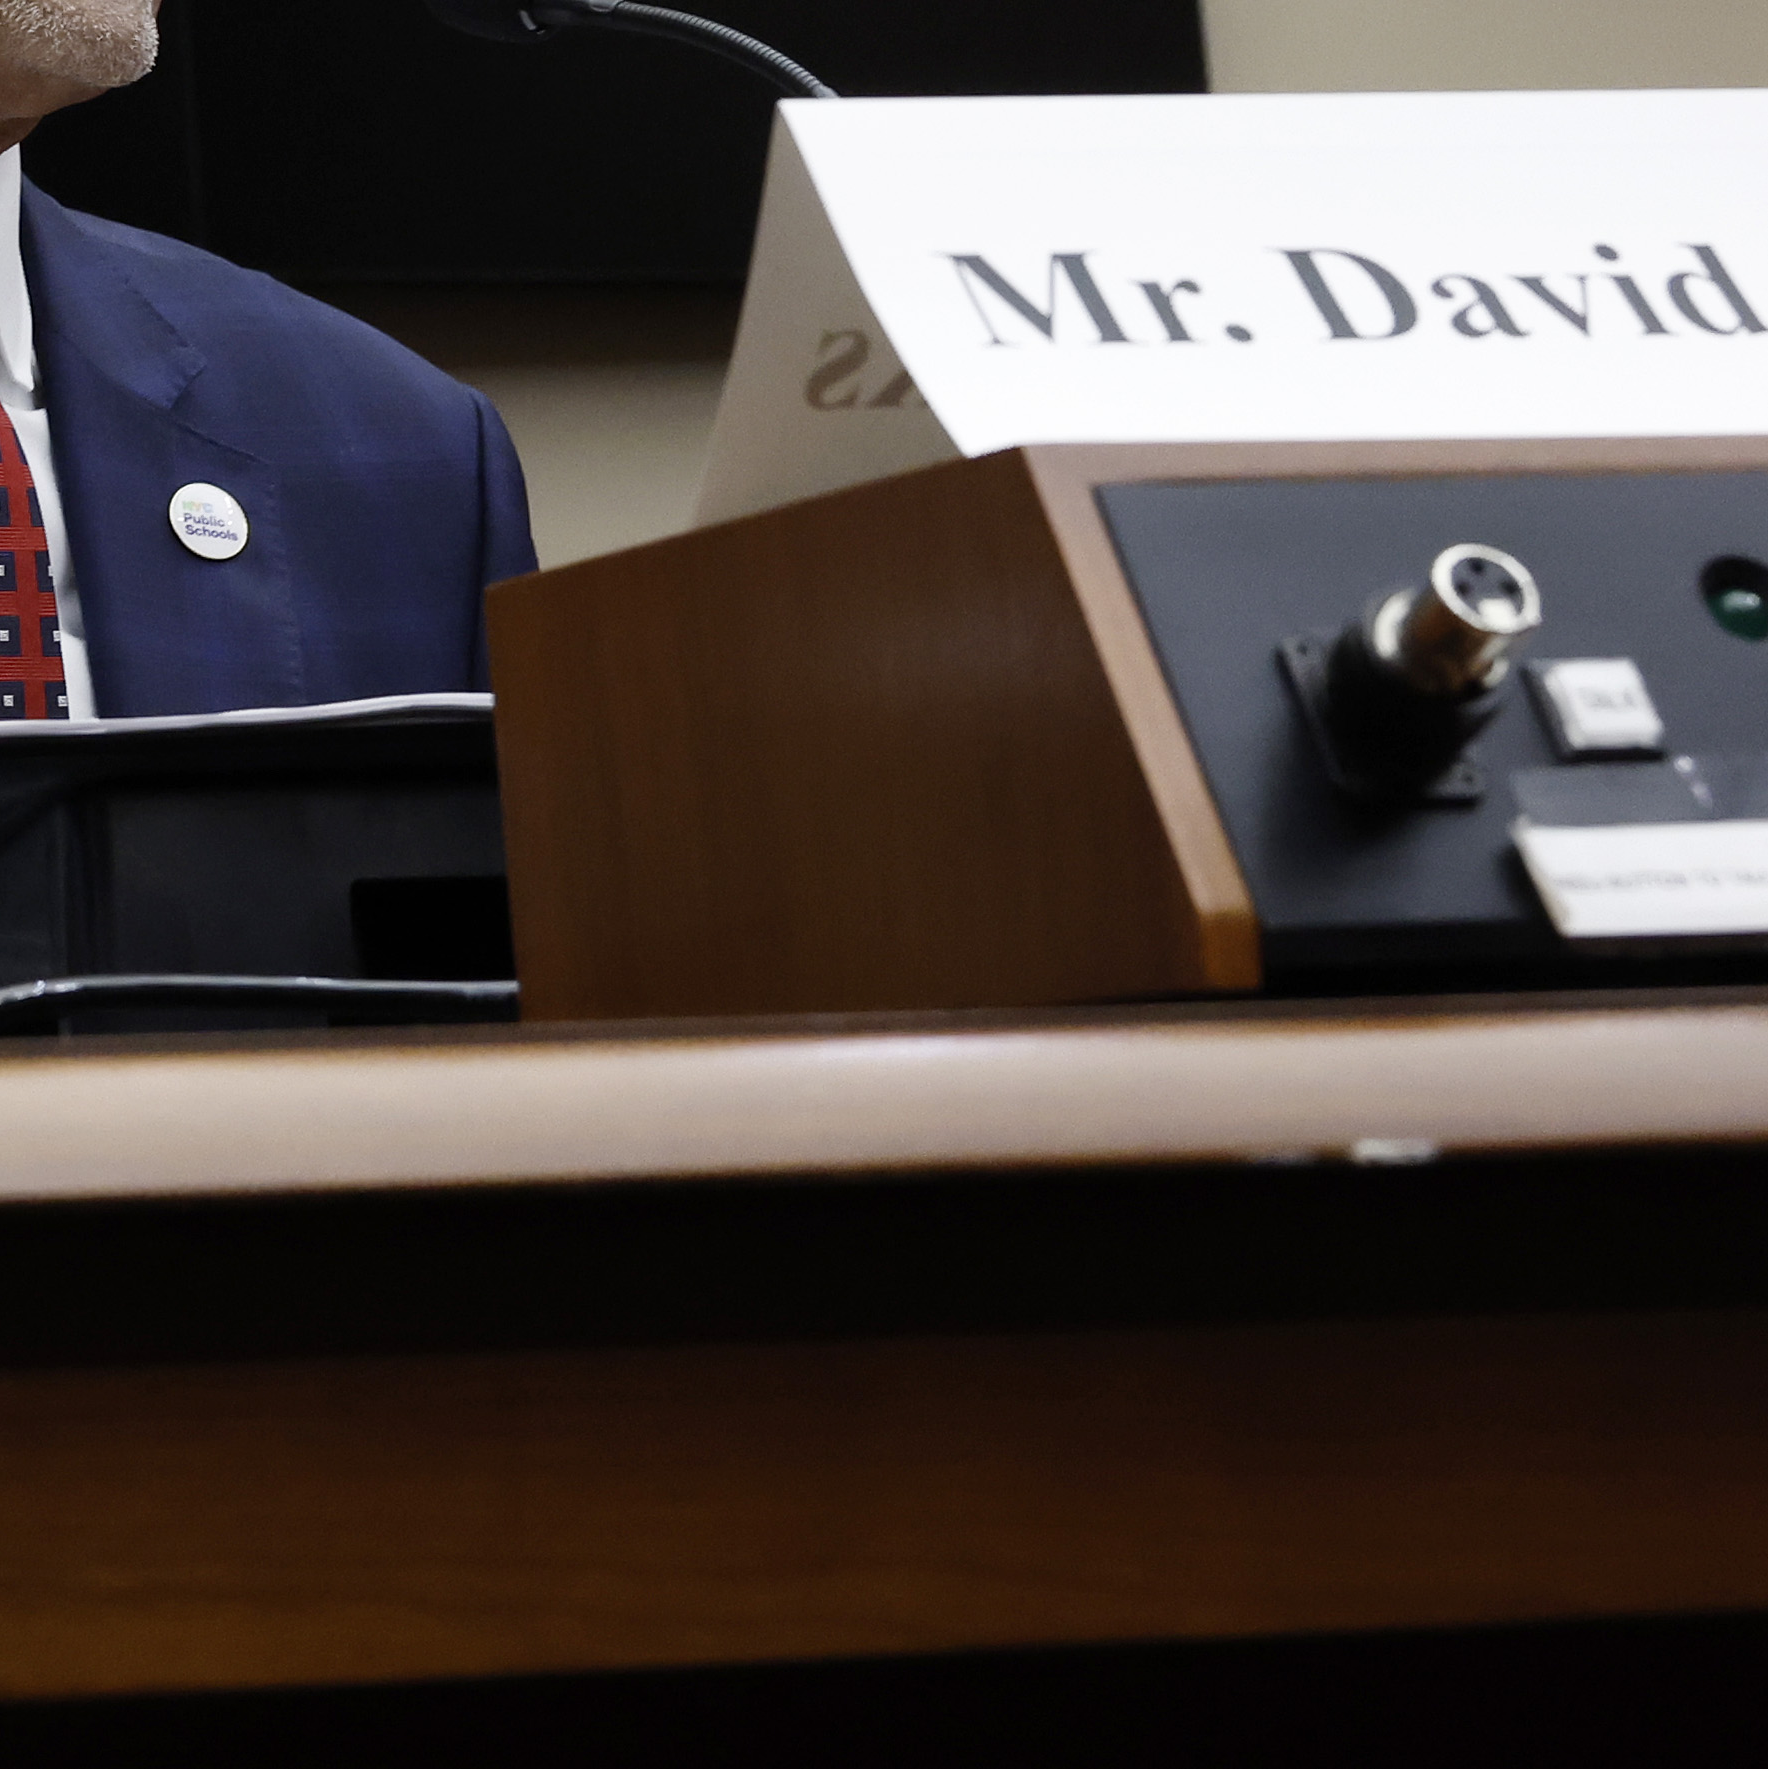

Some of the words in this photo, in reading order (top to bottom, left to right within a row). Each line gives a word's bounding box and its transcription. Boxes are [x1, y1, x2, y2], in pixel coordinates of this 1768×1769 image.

[943, 252, 1256, 347] Mr.
[1264, 243, 1768, 341] David
[184, 512, 225, 527] Public
[185, 524, 239, 541] Schools
